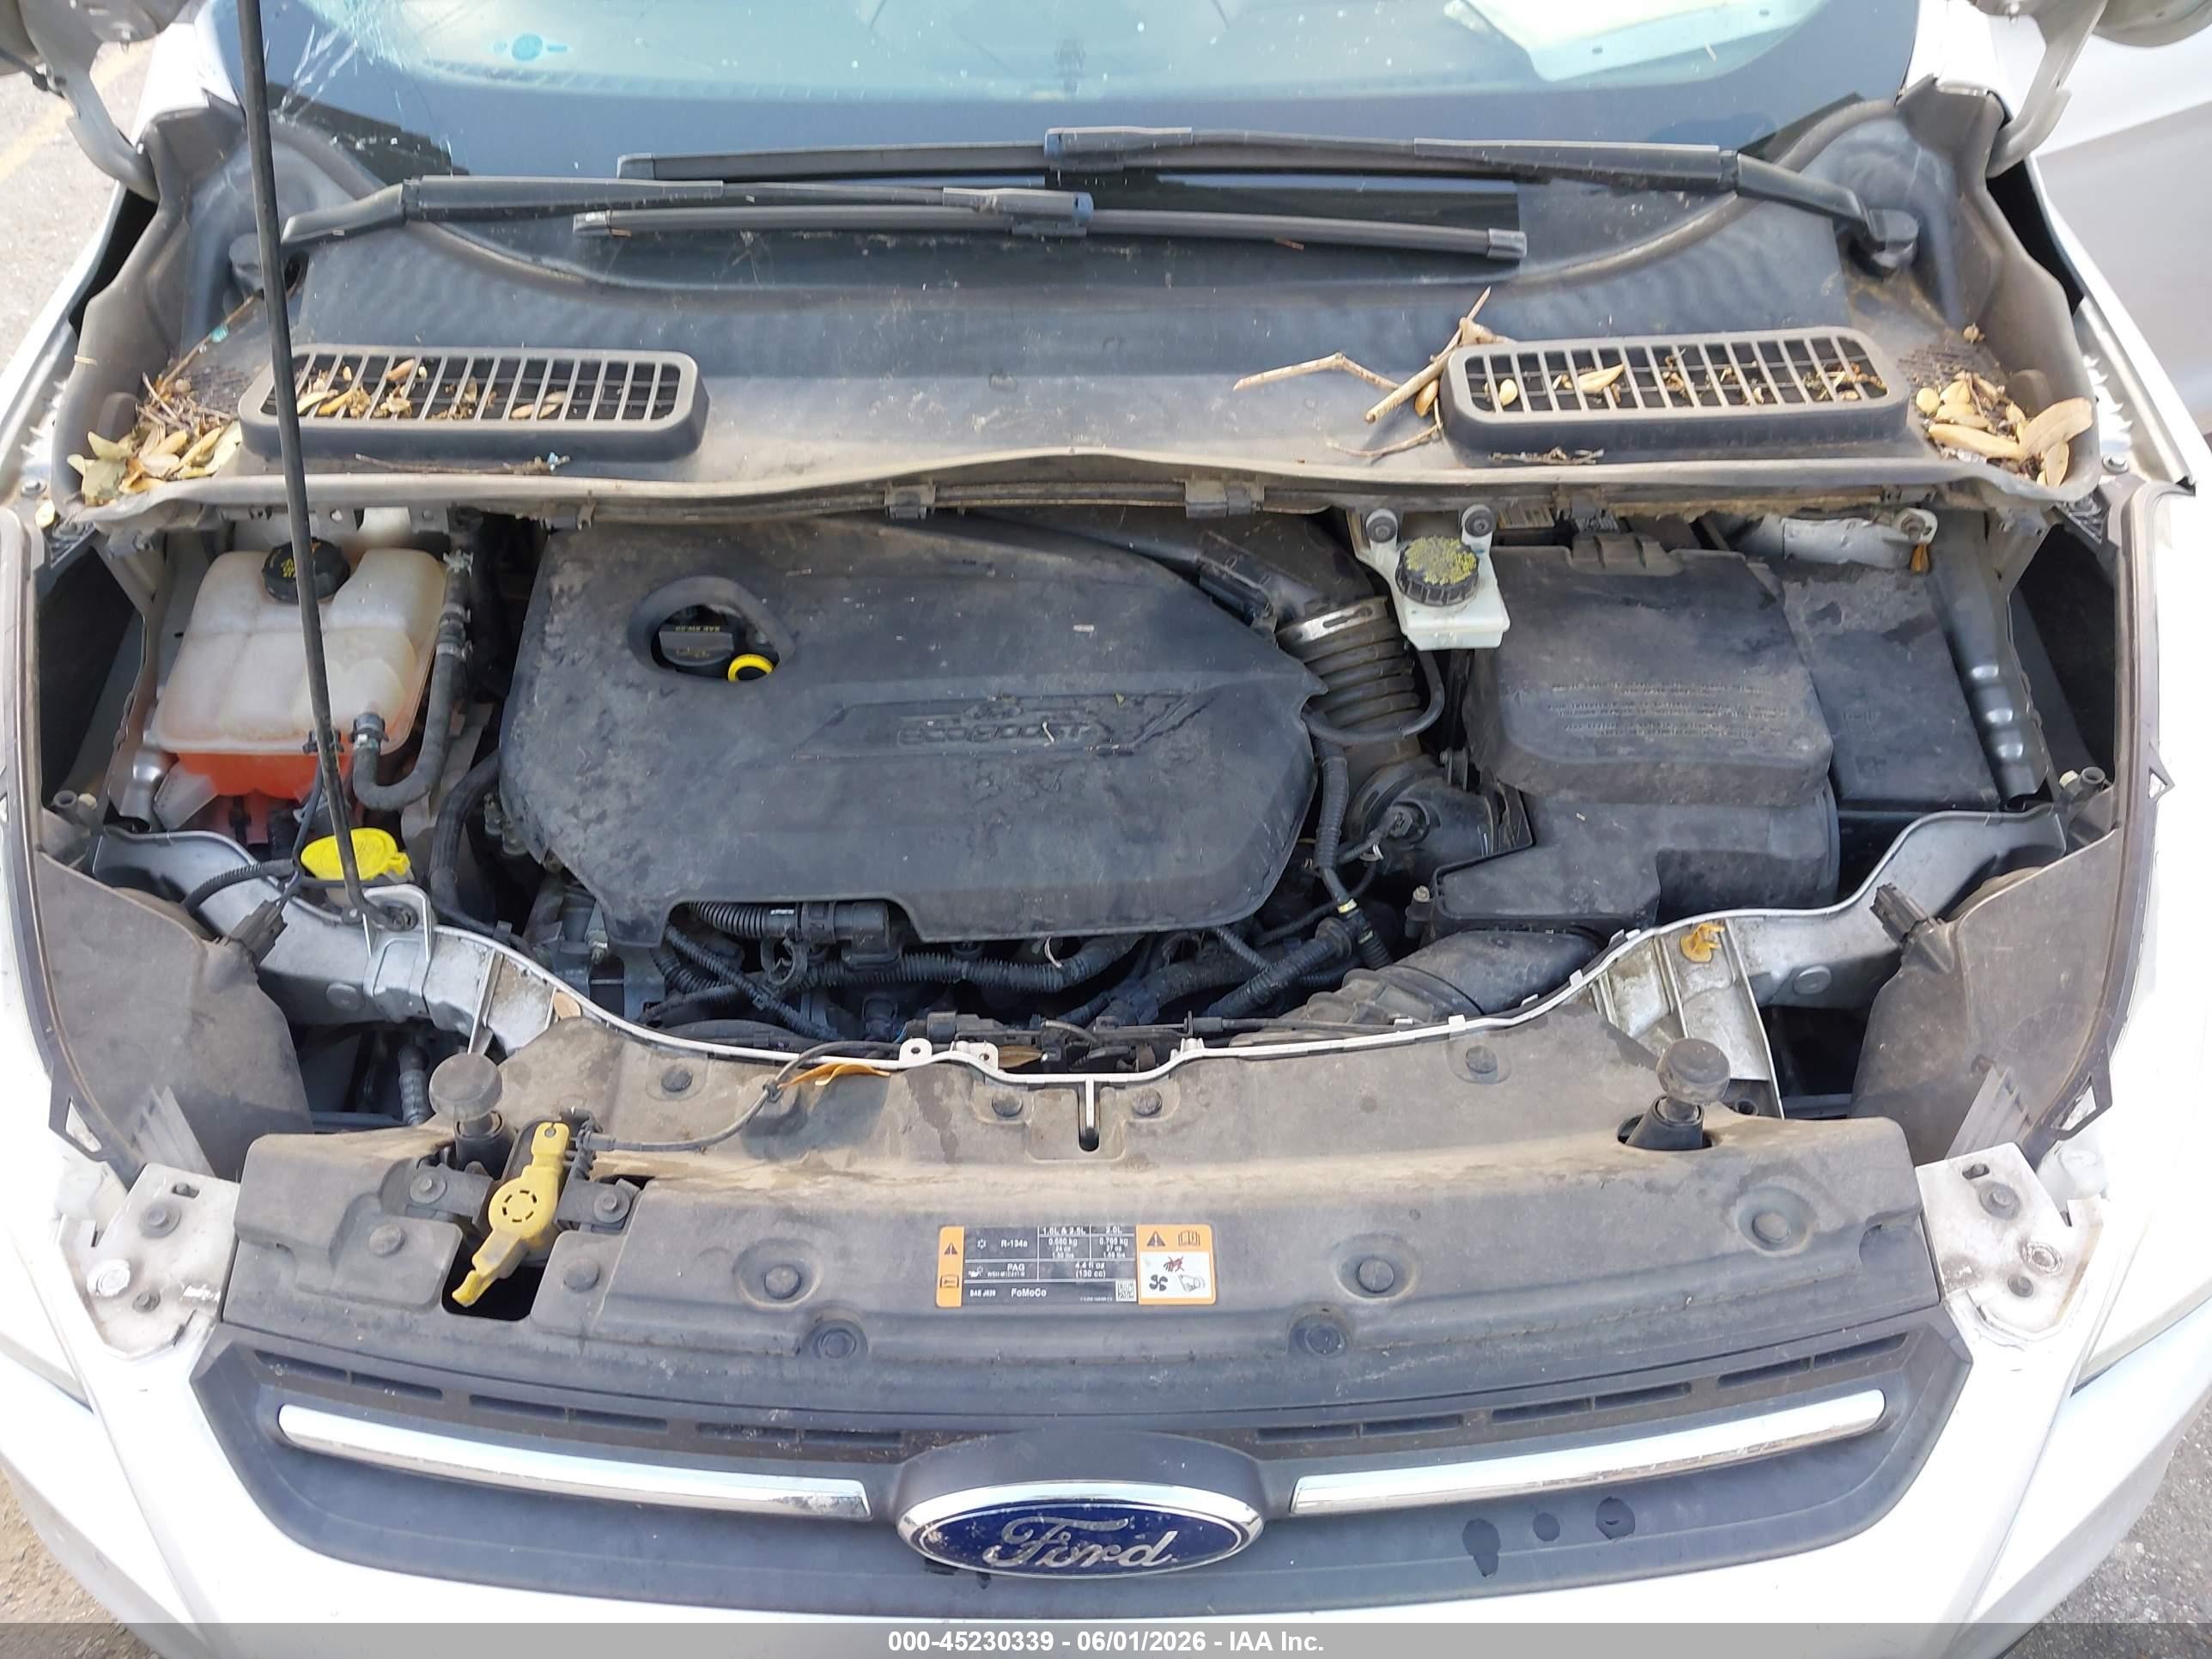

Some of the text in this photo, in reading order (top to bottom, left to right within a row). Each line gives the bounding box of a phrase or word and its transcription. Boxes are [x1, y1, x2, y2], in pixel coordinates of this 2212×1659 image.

[1105, 1225, 1123, 1235] 2.0L
[1000, 1239, 1028, 1249] R-134a
[1068, 1237, 1078, 1248] kg
[1119, 1237, 1128, 1247] kg
[1006, 1263, 1025, 1272] PAG
[1011, 1288, 1047, 1297] FoMoCo
[982, 1516, 1178, 1567] Ford
